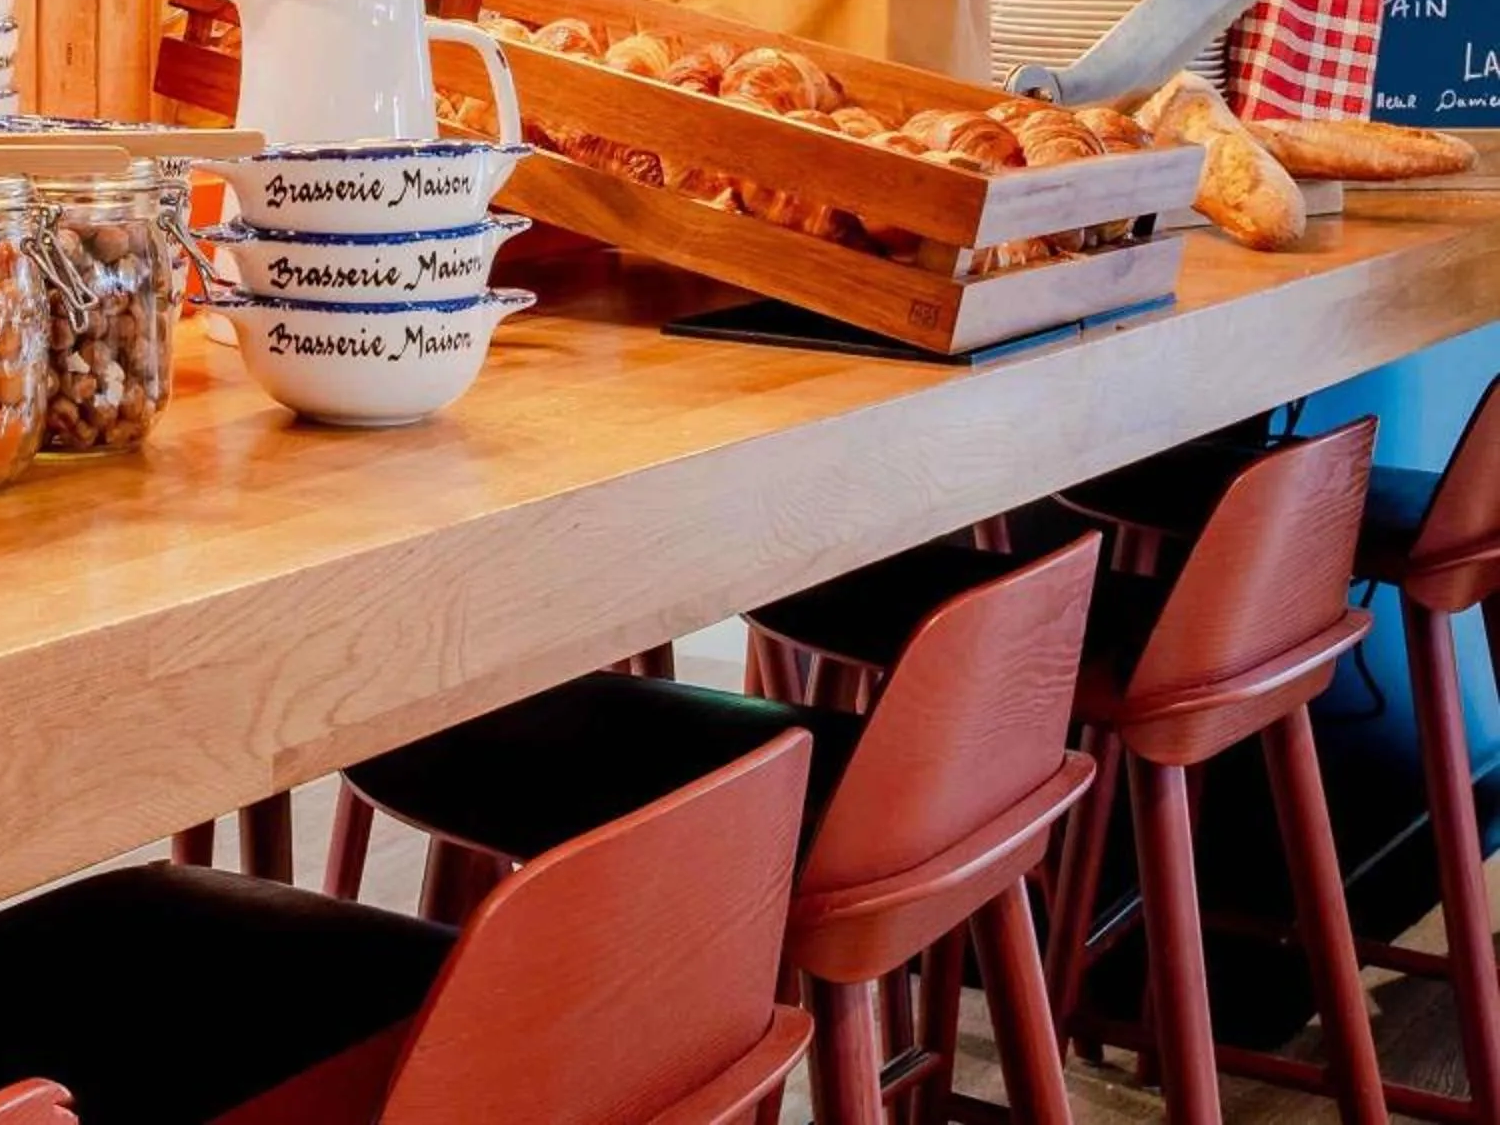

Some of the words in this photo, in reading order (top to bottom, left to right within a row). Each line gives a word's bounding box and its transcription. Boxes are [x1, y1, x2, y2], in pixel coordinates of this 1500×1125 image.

[265, 172, 384, 209] Brasserie
[388, 167, 473, 208] Maison
[268, 256, 402, 289] Brasserie
[403, 248, 484, 291] Maison
[267, 323, 386, 358] Brasserie
[388, 324, 472, 362] Maison
